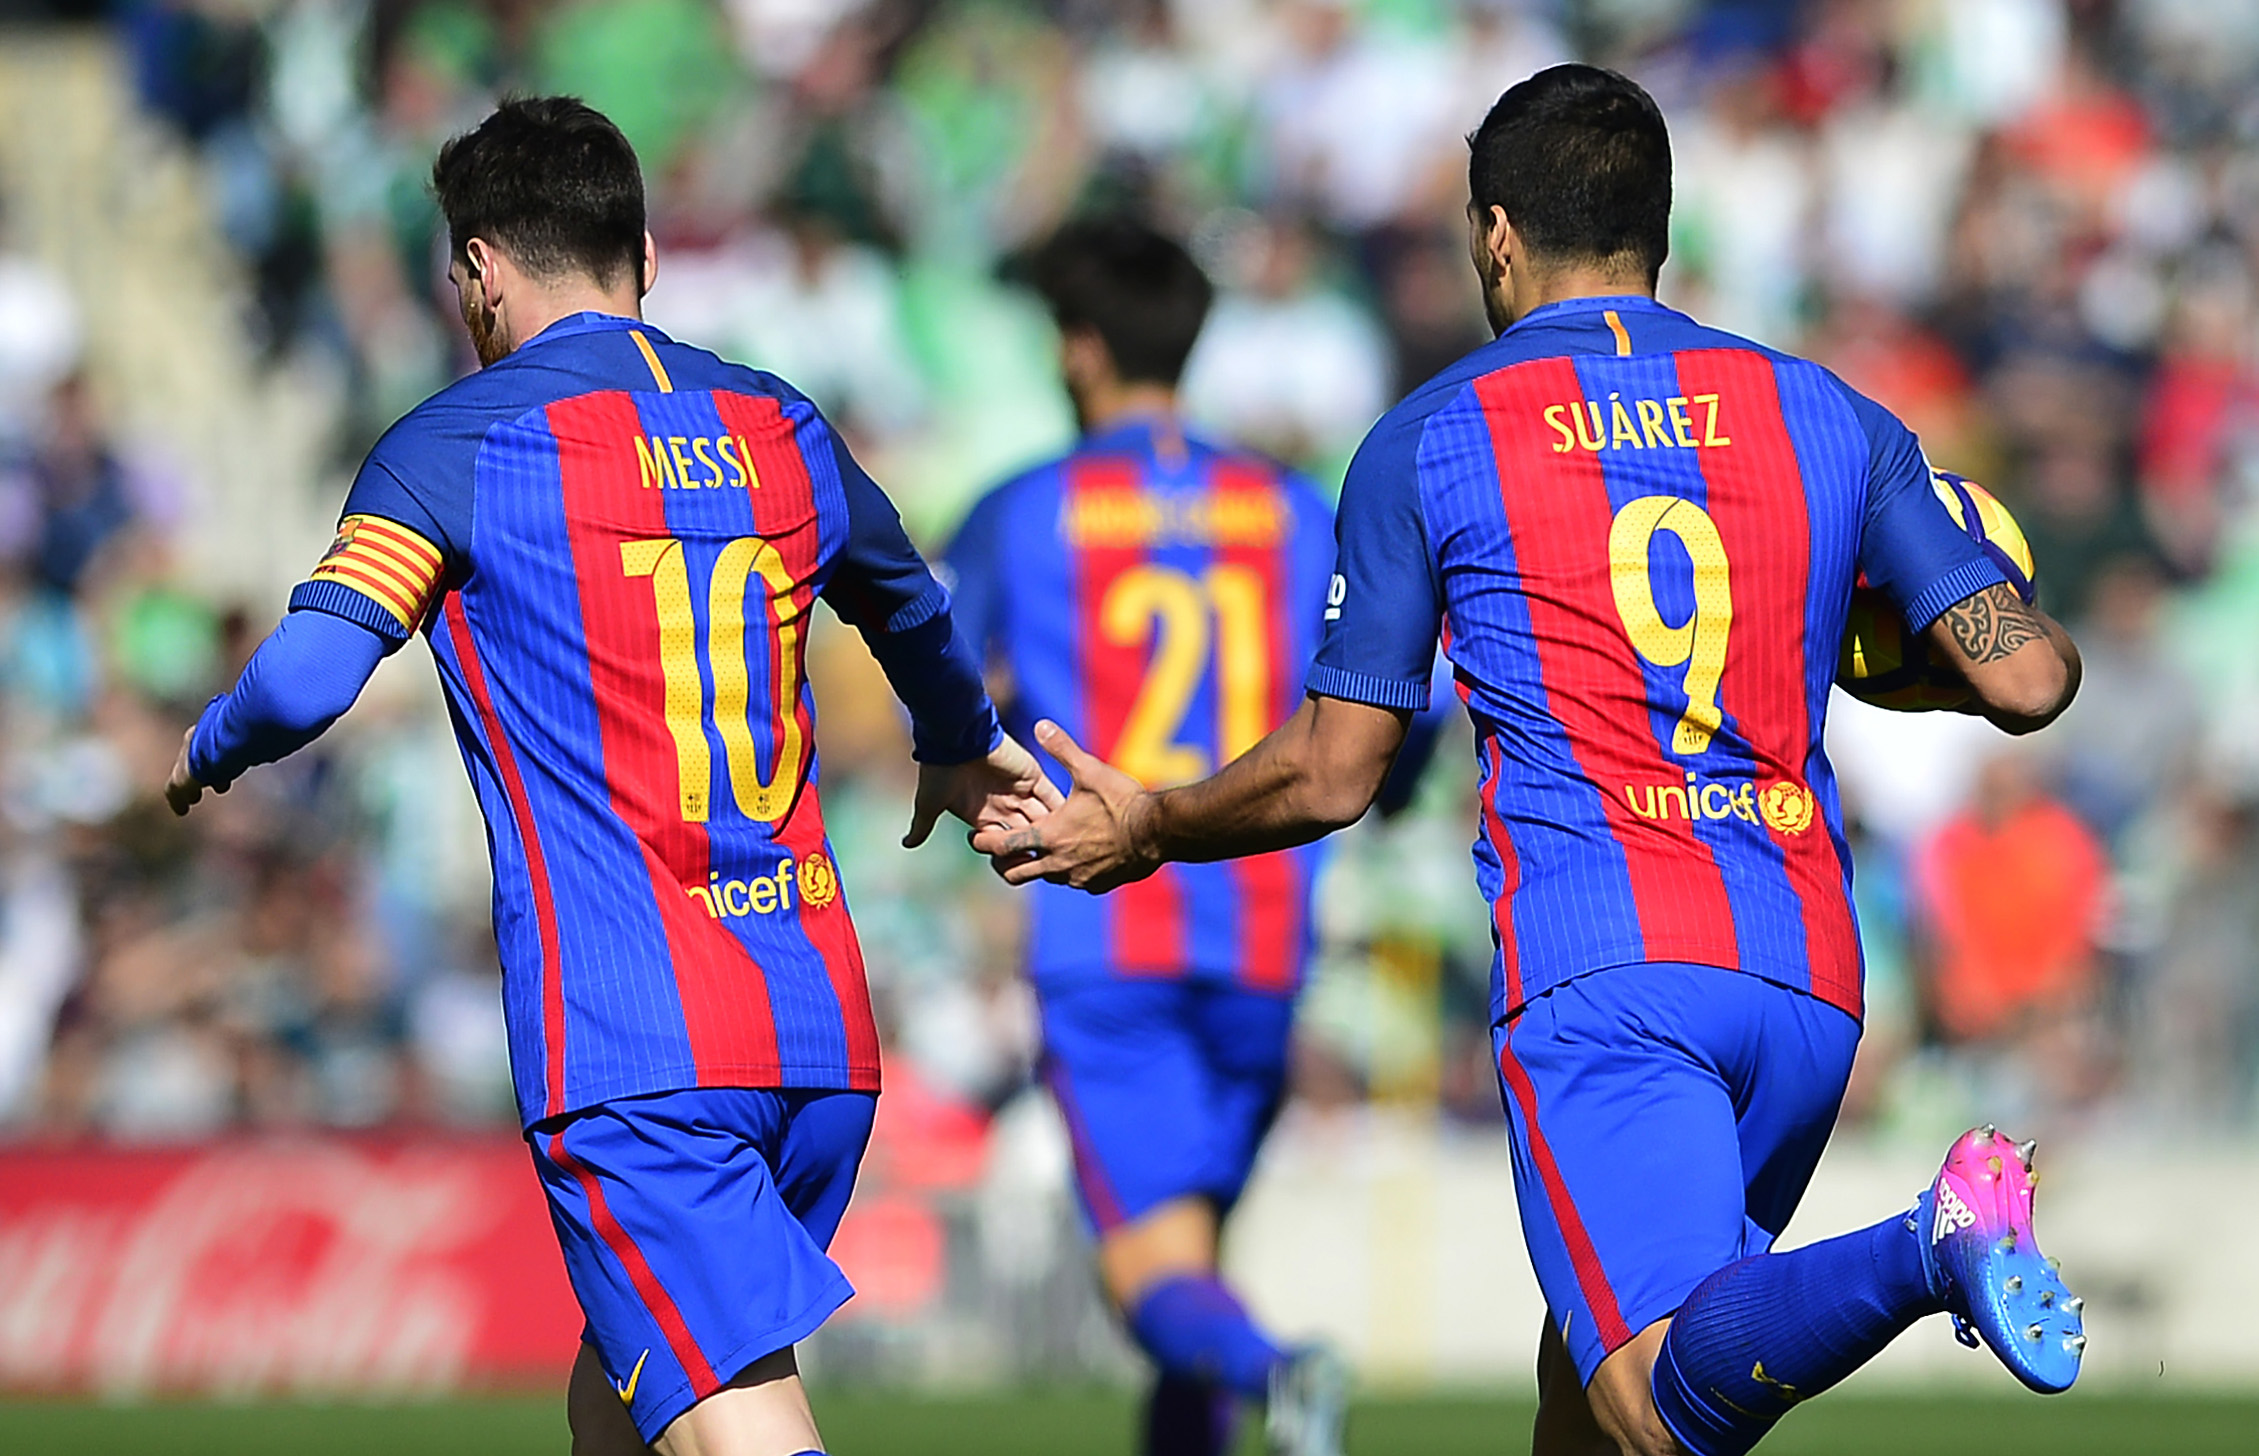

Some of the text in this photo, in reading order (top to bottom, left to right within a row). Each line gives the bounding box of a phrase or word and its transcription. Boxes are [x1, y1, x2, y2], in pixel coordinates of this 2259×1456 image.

[633, 435, 760, 489] MESSI
[1543, 392, 1732, 453] SUÁREZ
[619, 536, 801, 823] 10
[1101, 562, 1270, 789] 21
[1608, 495, 1733, 755] 9
